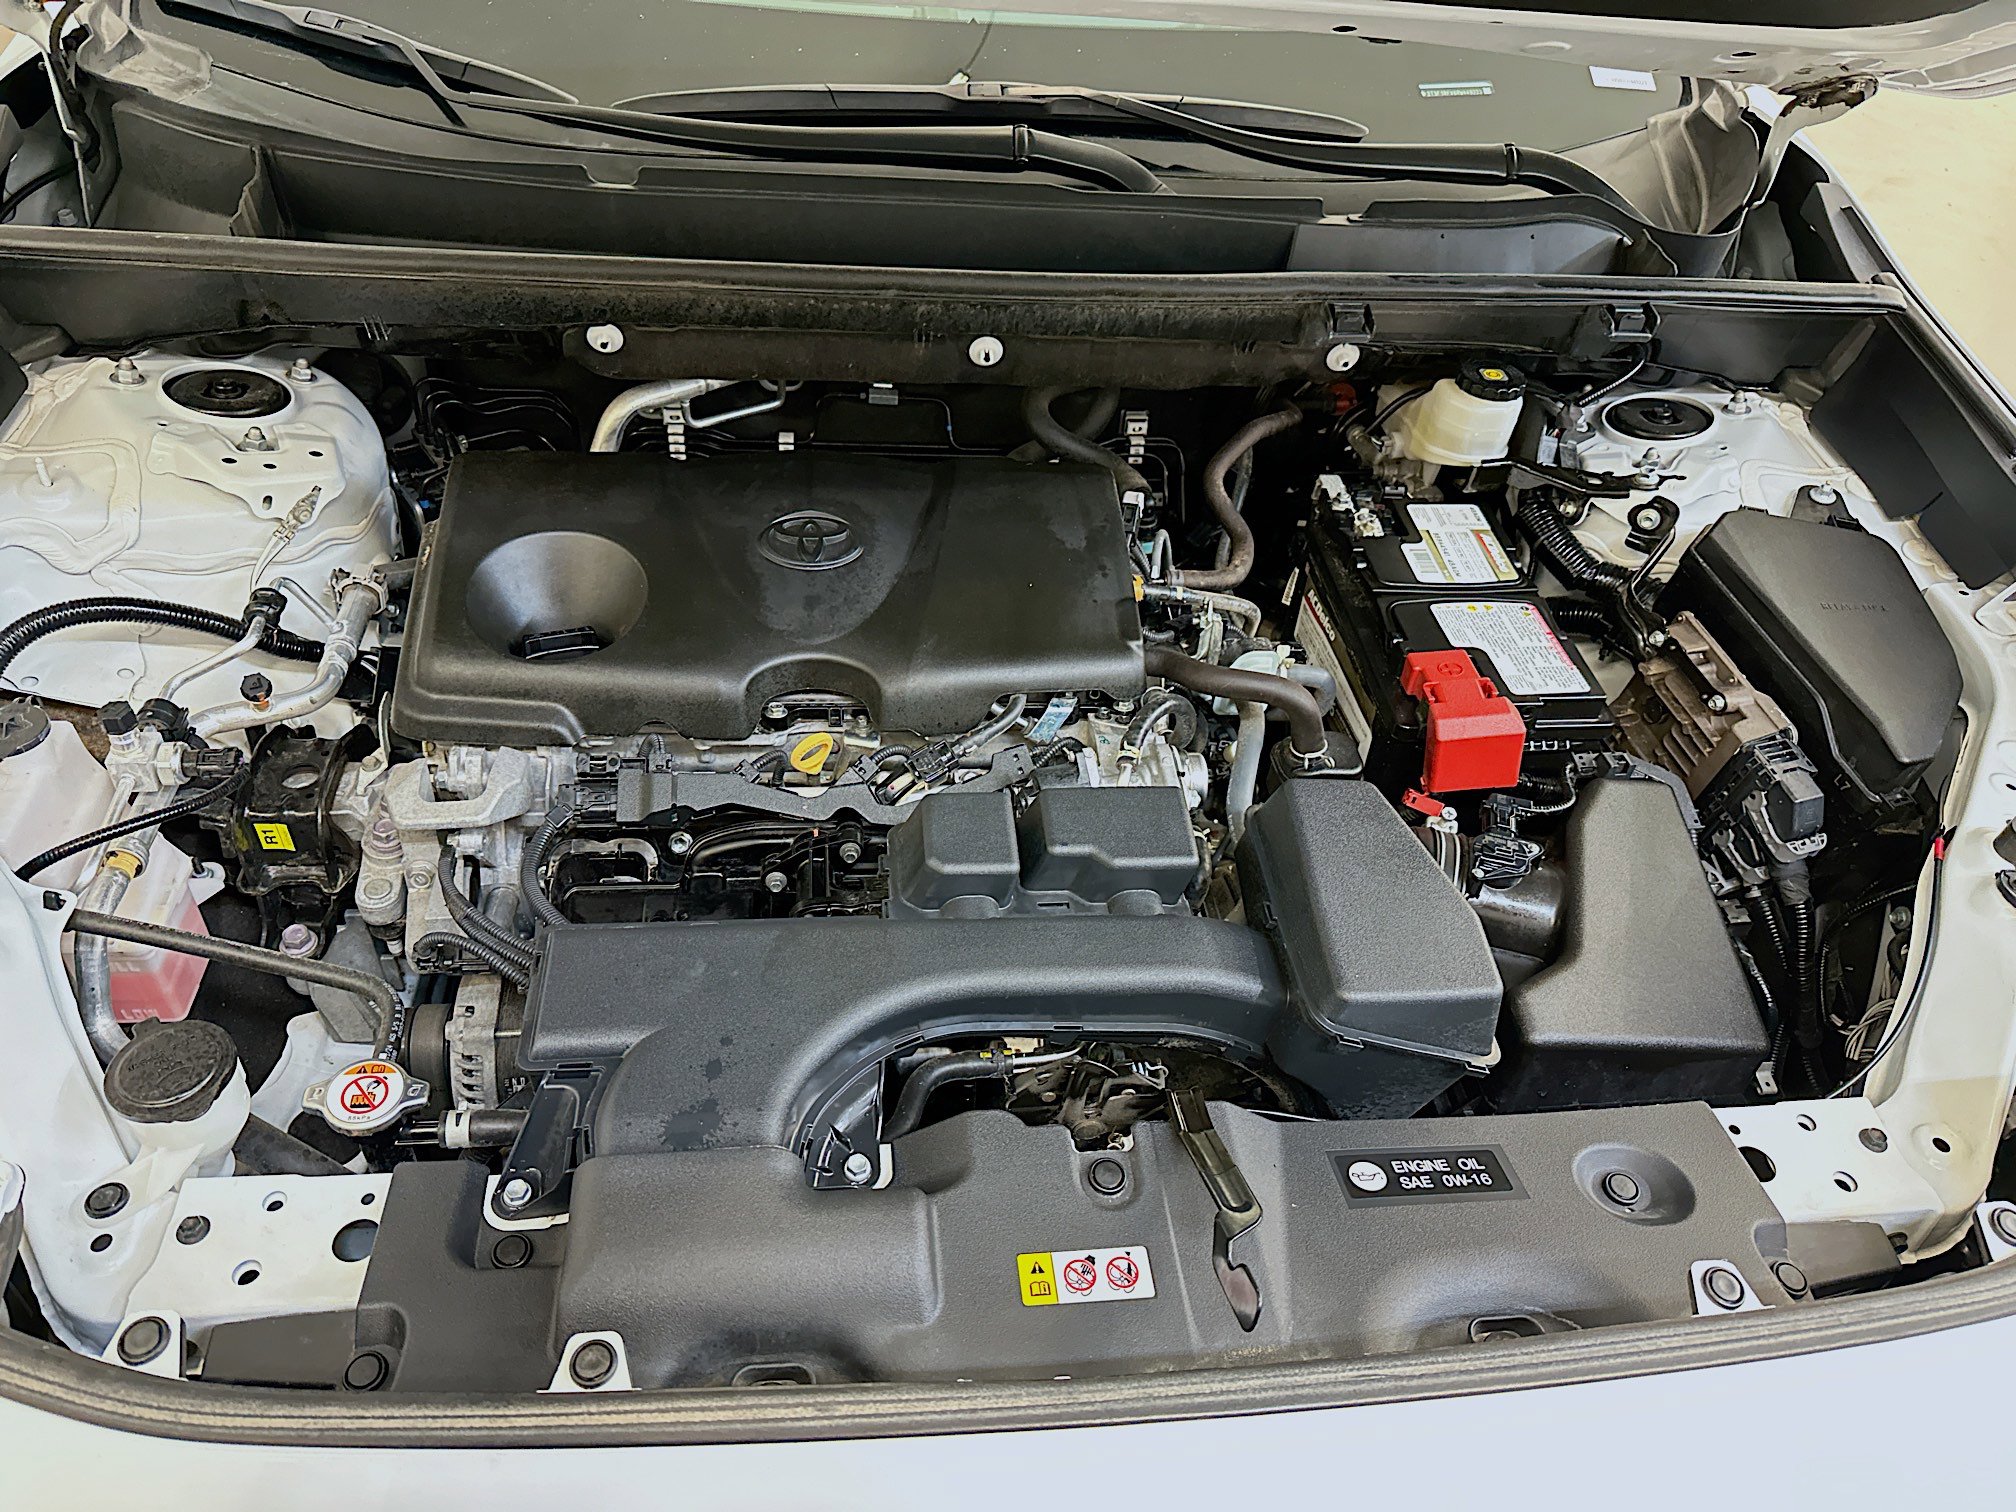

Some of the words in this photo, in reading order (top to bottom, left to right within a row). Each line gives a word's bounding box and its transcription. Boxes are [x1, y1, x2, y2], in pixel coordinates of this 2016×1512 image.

[1307, 588, 1336, 642] ACDelco
[261, 829, 279, 844] R1
[1390, 1158, 1451, 1174] ENGINE
[1457, 1156, 1486, 1171] OIL
[1399, 1174, 1435, 1190] SAE
[1441, 1172, 1493, 1188] 0W-16
